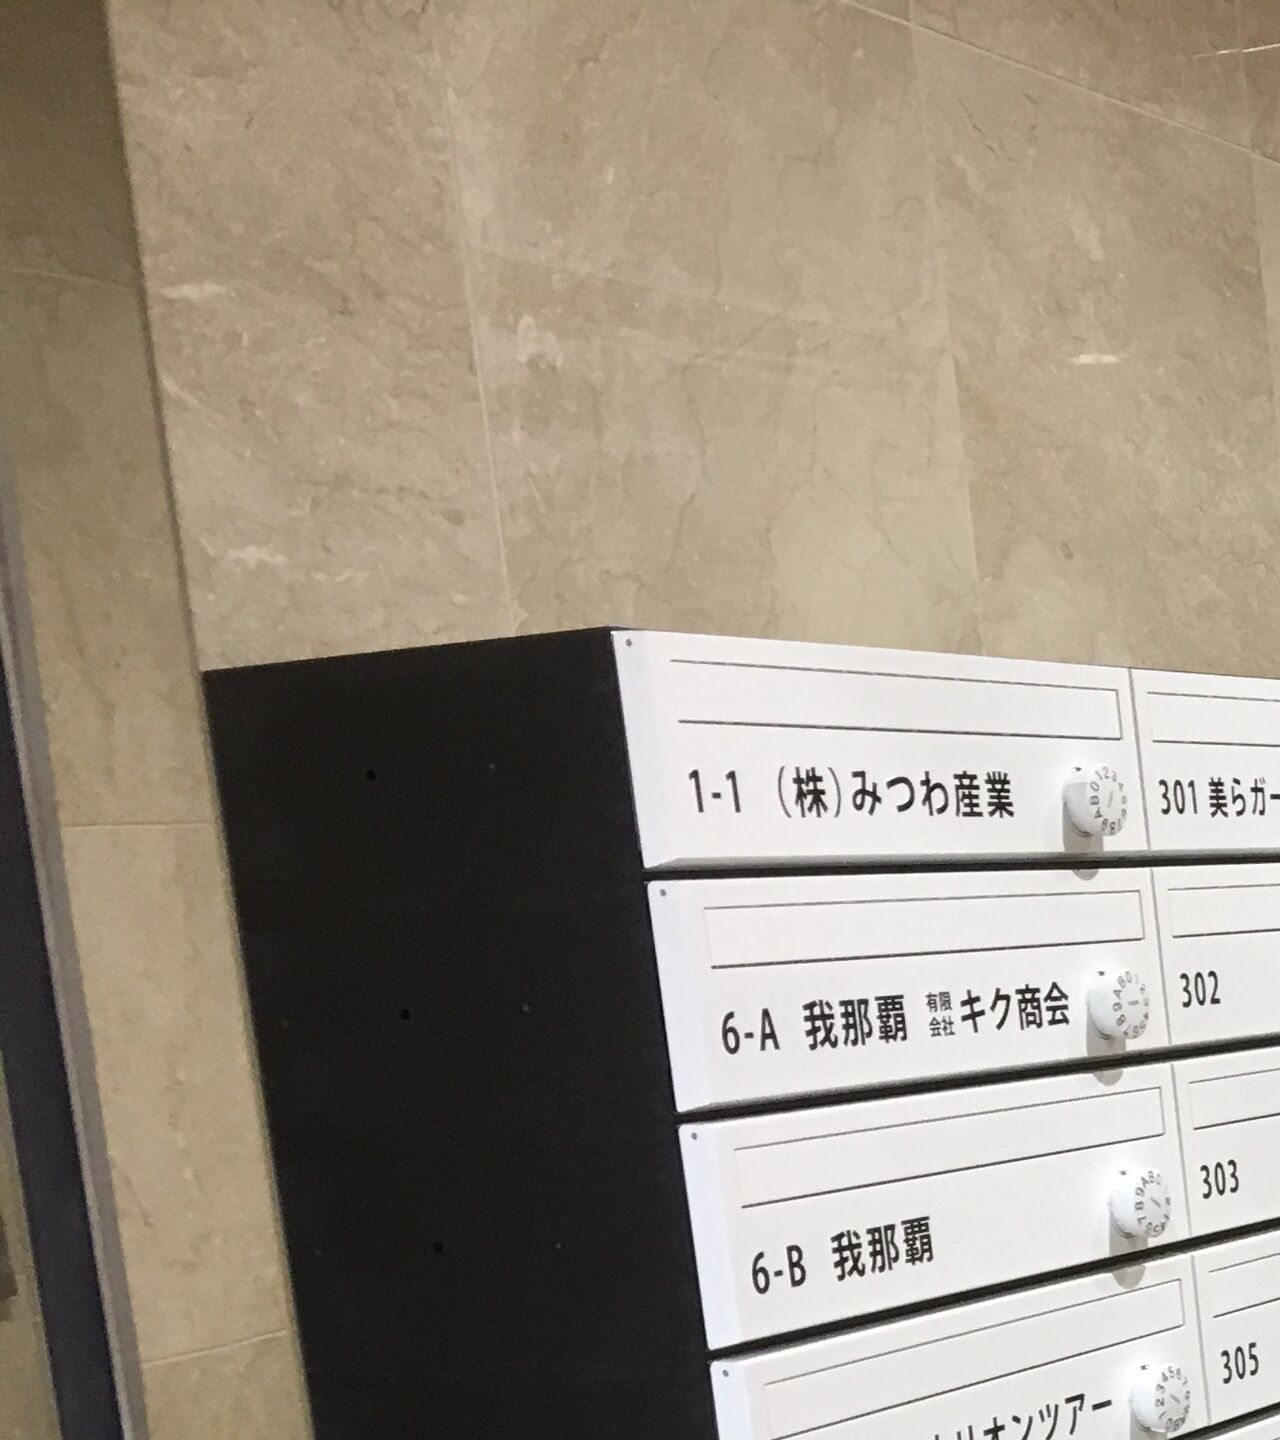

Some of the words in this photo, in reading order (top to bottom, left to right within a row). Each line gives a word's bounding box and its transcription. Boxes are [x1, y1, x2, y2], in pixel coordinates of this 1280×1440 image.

[688, 769, 741, 813] 1-1
[1158, 779, 1198, 815] 301
[1179, 970, 1221, 1008] 302
[721, 1006, 781, 1056] 6-A
[802, 994, 908, 1051] 我那覇
[960, 981, 1070, 1033] キク商会
[1199, 1159, 1240, 1200] 303
[751, 1244, 807, 1295] 6-B
[830, 1215, 934, 1282] 我那覇
[1220, 1341, 1260, 1385] 305
